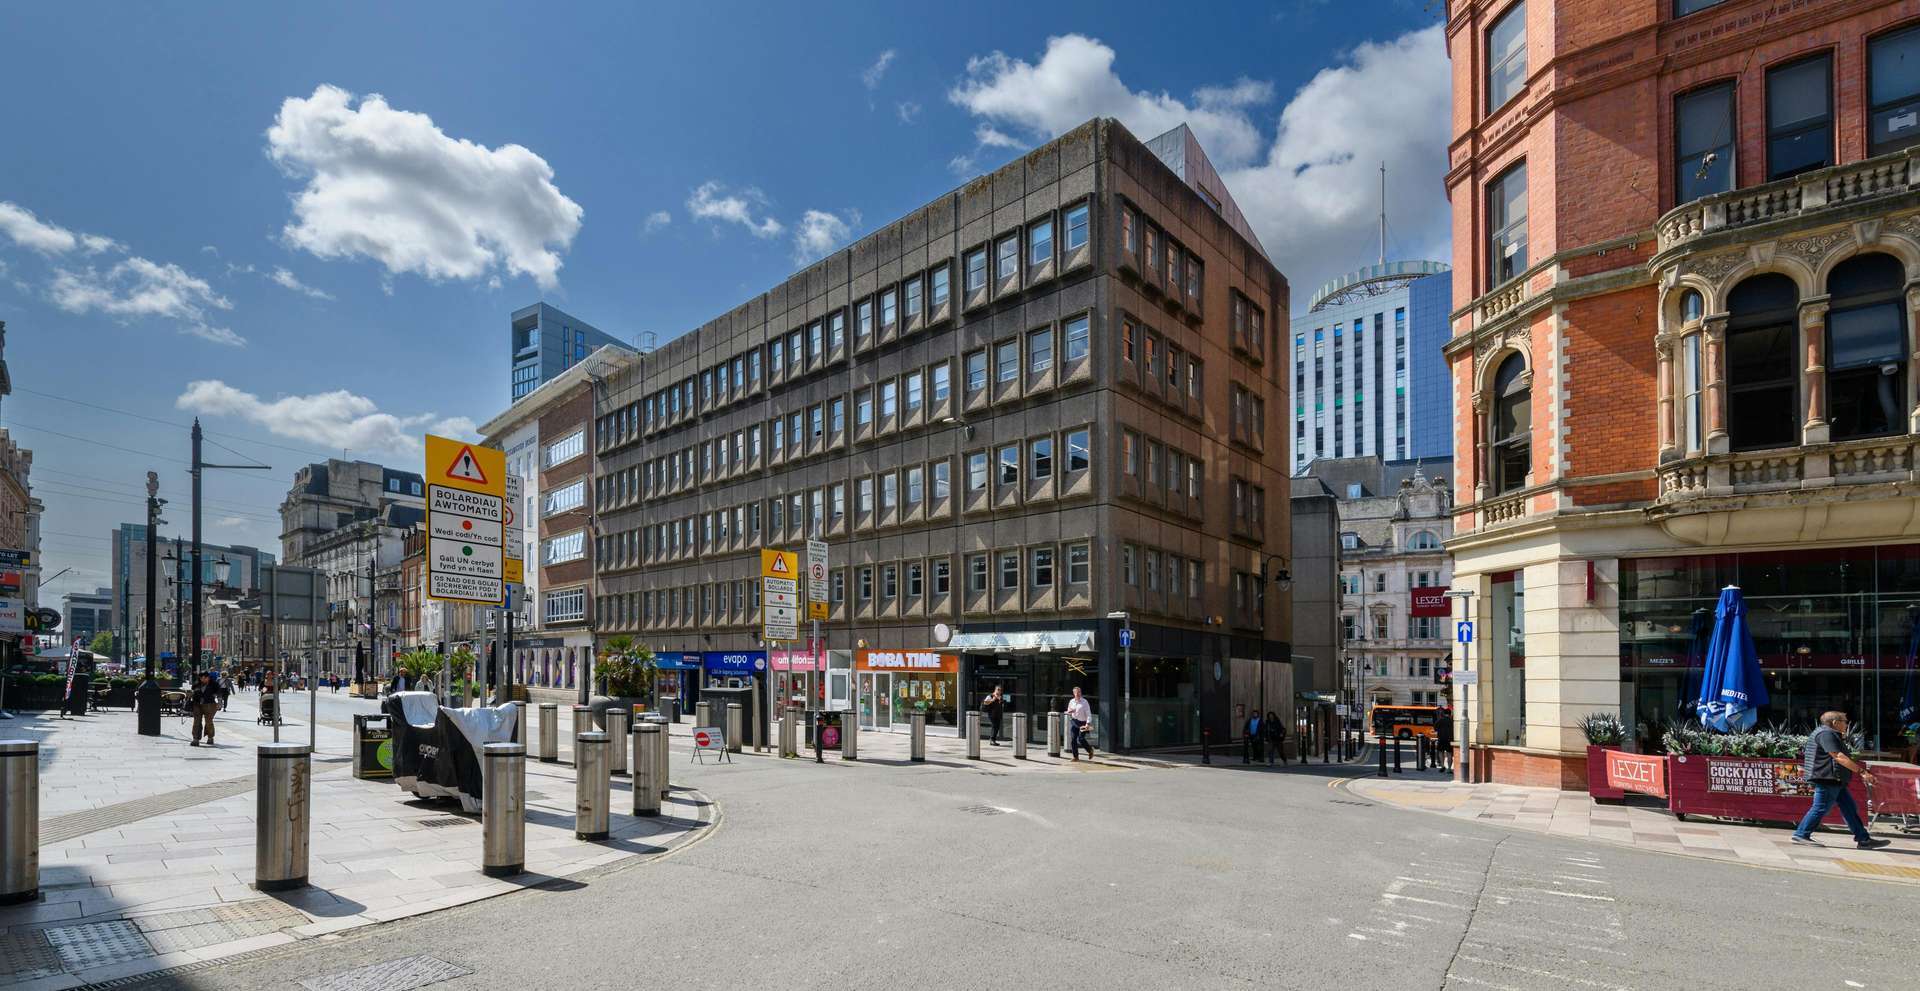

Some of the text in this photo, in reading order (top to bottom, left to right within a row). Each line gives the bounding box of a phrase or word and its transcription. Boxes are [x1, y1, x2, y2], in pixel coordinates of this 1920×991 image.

[436, 490, 497, 508] BOLARDIAU
[435, 500, 498, 517] AWTOMATIG
[434, 527, 453, 536] Wedi
[439, 562, 456, 570] fynd
[471, 560, 494, 568] cerbyd
[436, 581, 477, 591] SICRHEWCH
[767, 579, 794, 587] AUTOMATIC
[436, 588, 475, 596] BOLARDIAU
[723, 654, 748, 667] evapo
[777, 655, 807, 665] amlifon
[867, 652, 941, 667] BOBA TIME
[1612, 759, 1657, 784] LESZET
[1710, 766, 1772, 779] COCKTAILS
[1711, 777, 1773, 787] TURKISH BEERS
[1744, 786, 1773, 794] OPTIONS
